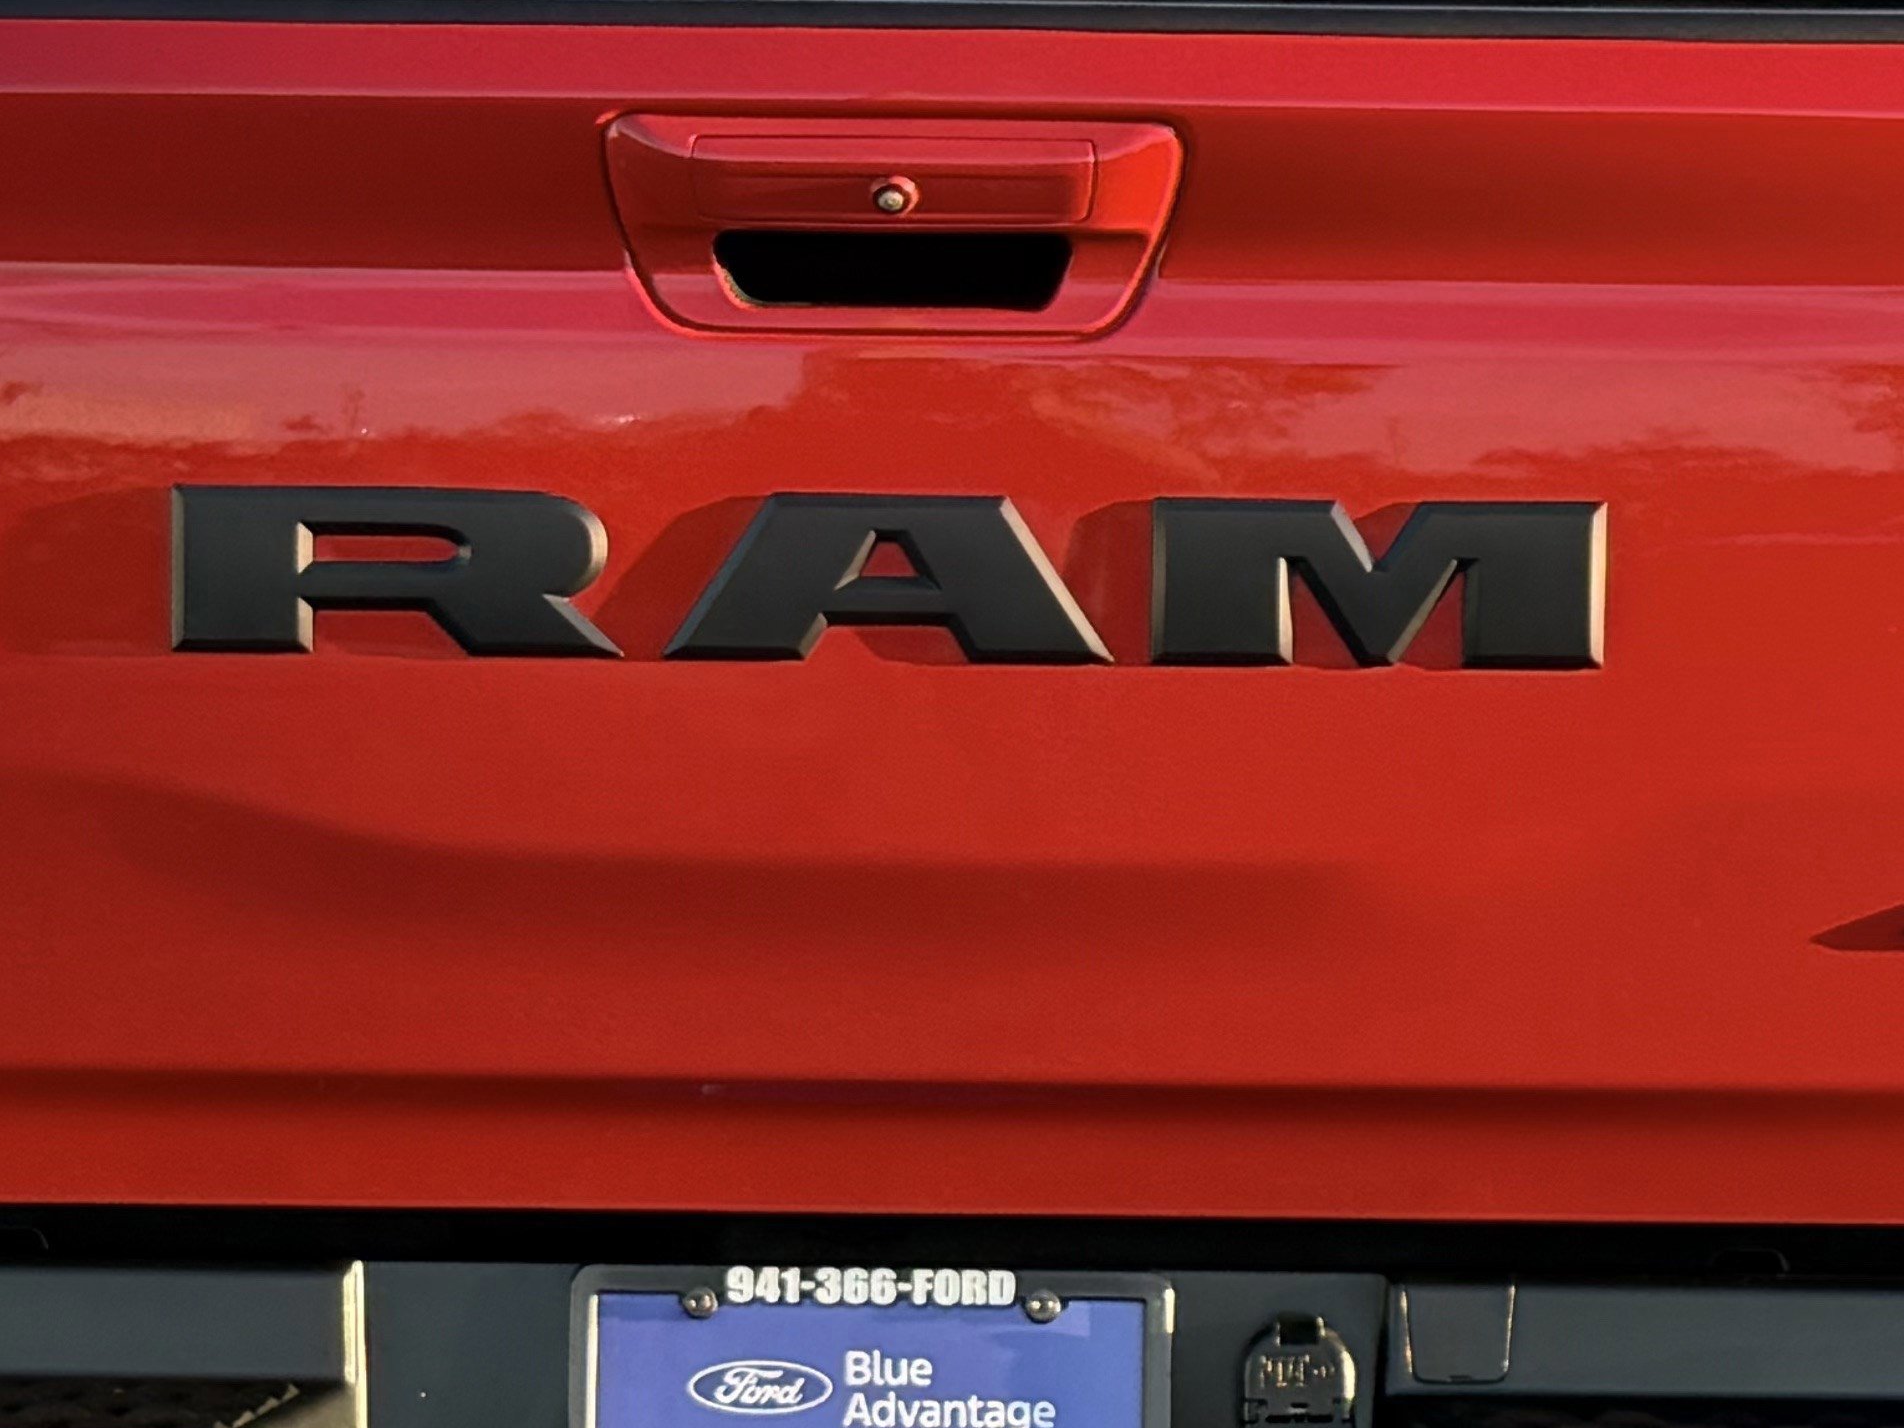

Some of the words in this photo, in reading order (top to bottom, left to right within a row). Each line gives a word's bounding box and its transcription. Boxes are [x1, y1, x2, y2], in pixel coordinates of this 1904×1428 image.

[171, 483, 1604, 670] RAM
[725, 1265, 1017, 1306] 941-366-FORD
[713, 1366, 805, 1405] Ford
[844, 1350, 933, 1387] Blue
